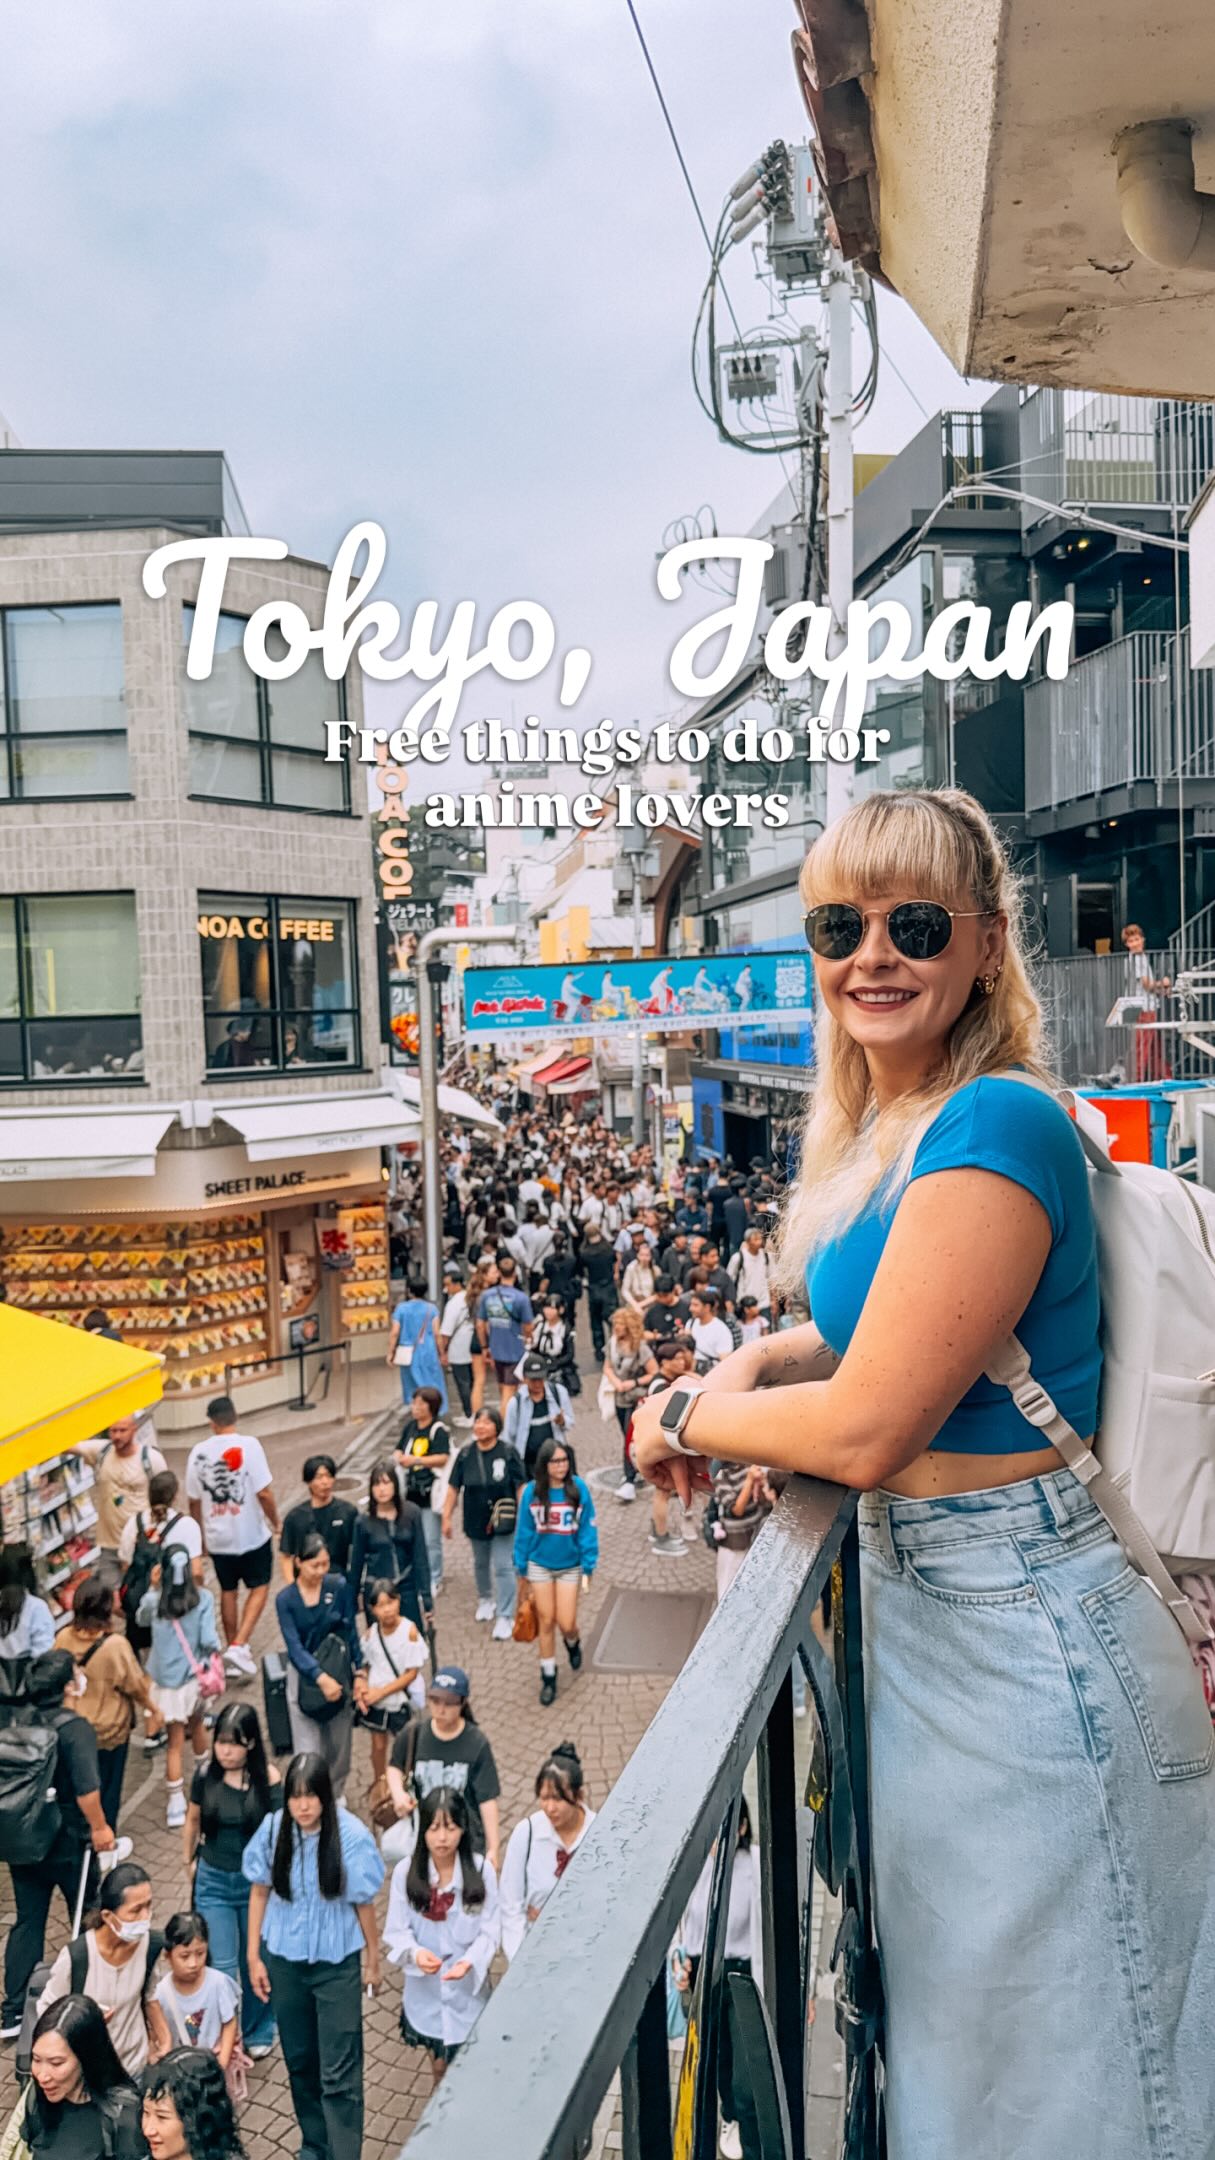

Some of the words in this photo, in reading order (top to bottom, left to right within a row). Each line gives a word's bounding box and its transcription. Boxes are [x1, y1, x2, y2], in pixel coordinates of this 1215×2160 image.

[387, 902, 435, 918] ジェラート
[255, 1170, 306, 1191] PALACE
